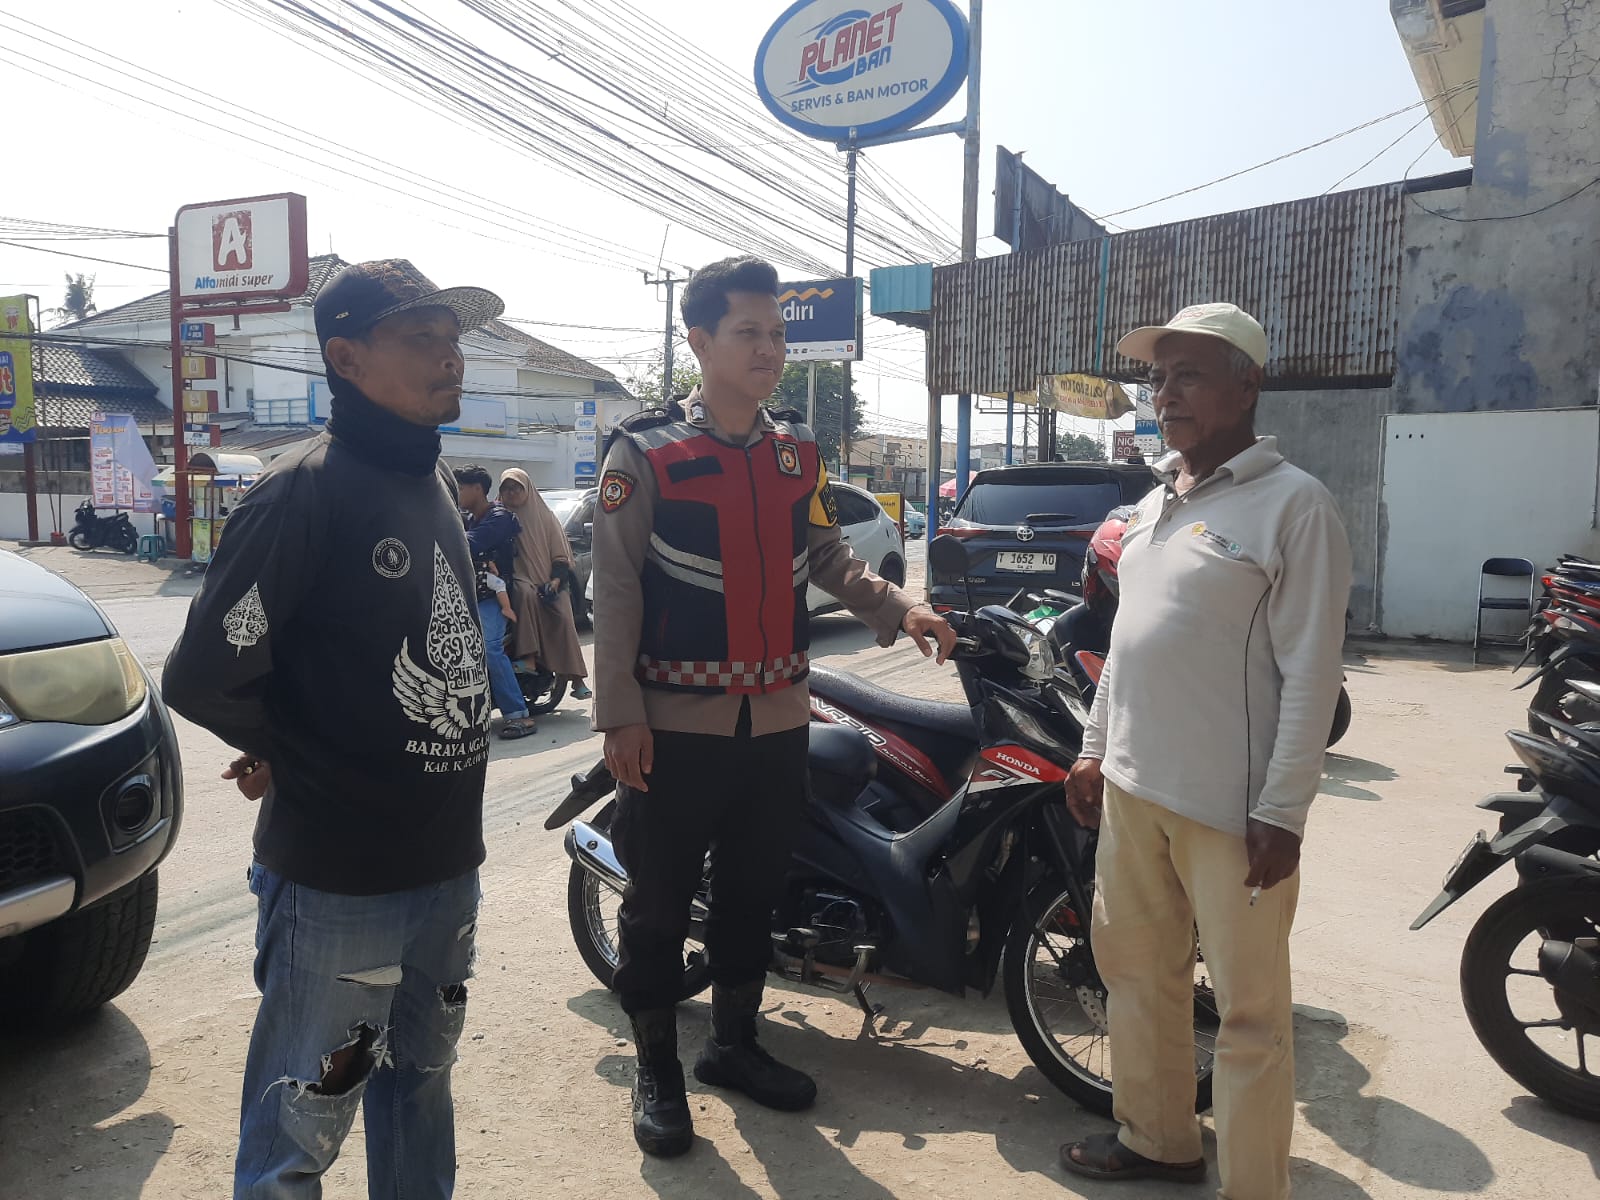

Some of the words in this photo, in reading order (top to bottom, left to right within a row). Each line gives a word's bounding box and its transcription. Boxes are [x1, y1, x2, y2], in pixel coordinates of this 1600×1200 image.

[799, 3, 903, 82] PLANET
[854, 46, 891, 76] BAN
[791, 93, 832, 113] SERVIS
[834, 92, 844, 105] &
[847, 87, 874, 103] BAN
[877, 78, 928, 98] MOTOR
[195, 274, 240, 290] Alfamidi
[242, 274, 274, 287] super
[782, 300, 814, 321] diri
[999, 553, 1005, 563] T
[1010, 553, 1034, 565] 1652
[405, 740, 467, 757] BARAYA
[996, 751, 1041, 775] HONDA
